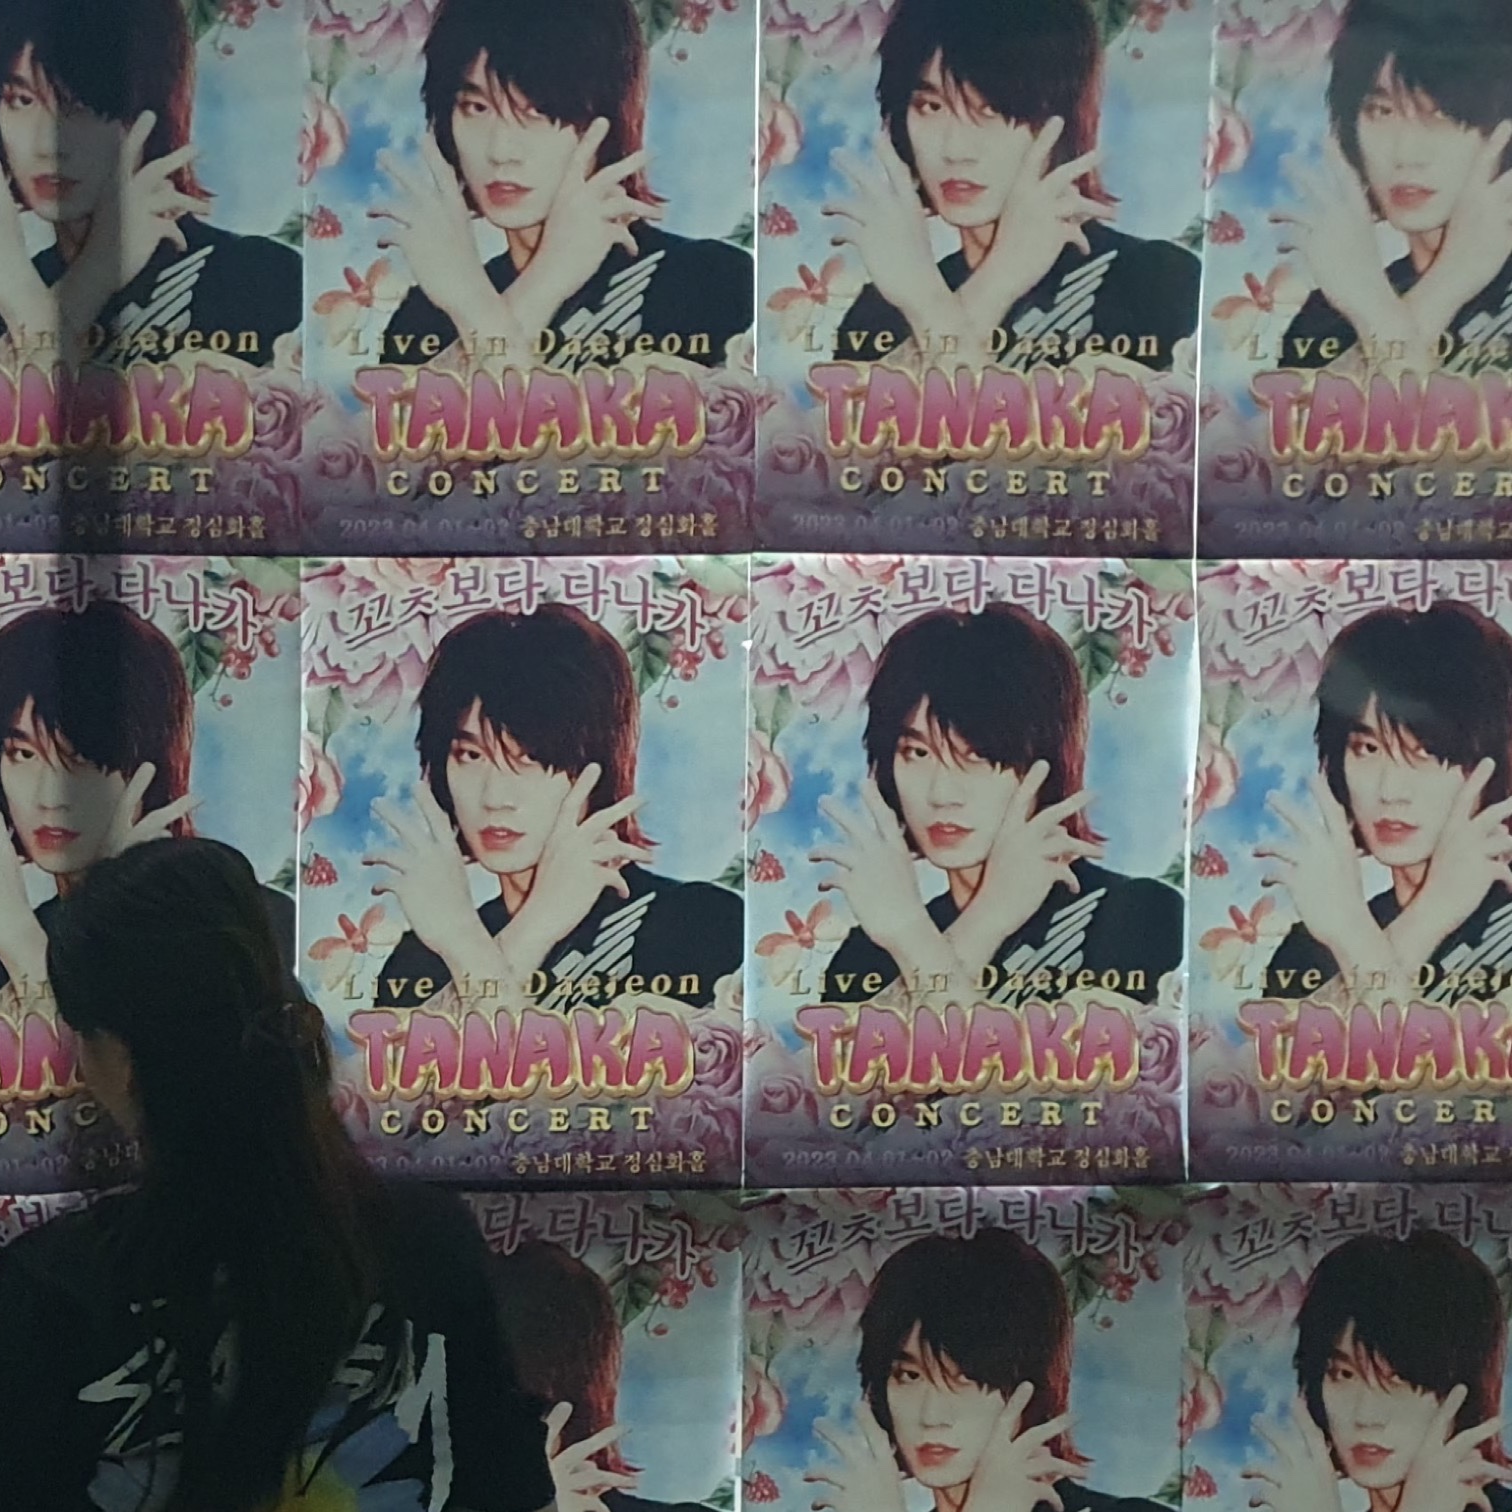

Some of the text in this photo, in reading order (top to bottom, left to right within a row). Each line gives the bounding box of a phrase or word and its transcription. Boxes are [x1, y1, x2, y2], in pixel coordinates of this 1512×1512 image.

[81, 323, 259, 354] Daejeon
[349, 326, 710, 358] Live Daejeon
[804, 325, 1160, 359] Live Daejeon
[1247, 333, 1340, 360] Live
[349, 360, 708, 463] TANAKA
[803, 361, 1155, 461] TANAKA
[386, 465, 665, 497] CONCERT
[838, 466, 1111, 495] CONCERT
[343, 967, 700, 1001] Live Daejeon
[791, 962, 1150, 995] Live Daejeon
[1233, 964, 1323, 990] Live
[344, 1000, 697, 1103] TANAKA
[793, 995, 1146, 1098] TANAKA
[1233, 995, 1512, 1092] TANAK
[379, 1103, 654, 1136] CONCERT
[831, 1098, 1105, 1131] CONCERT
